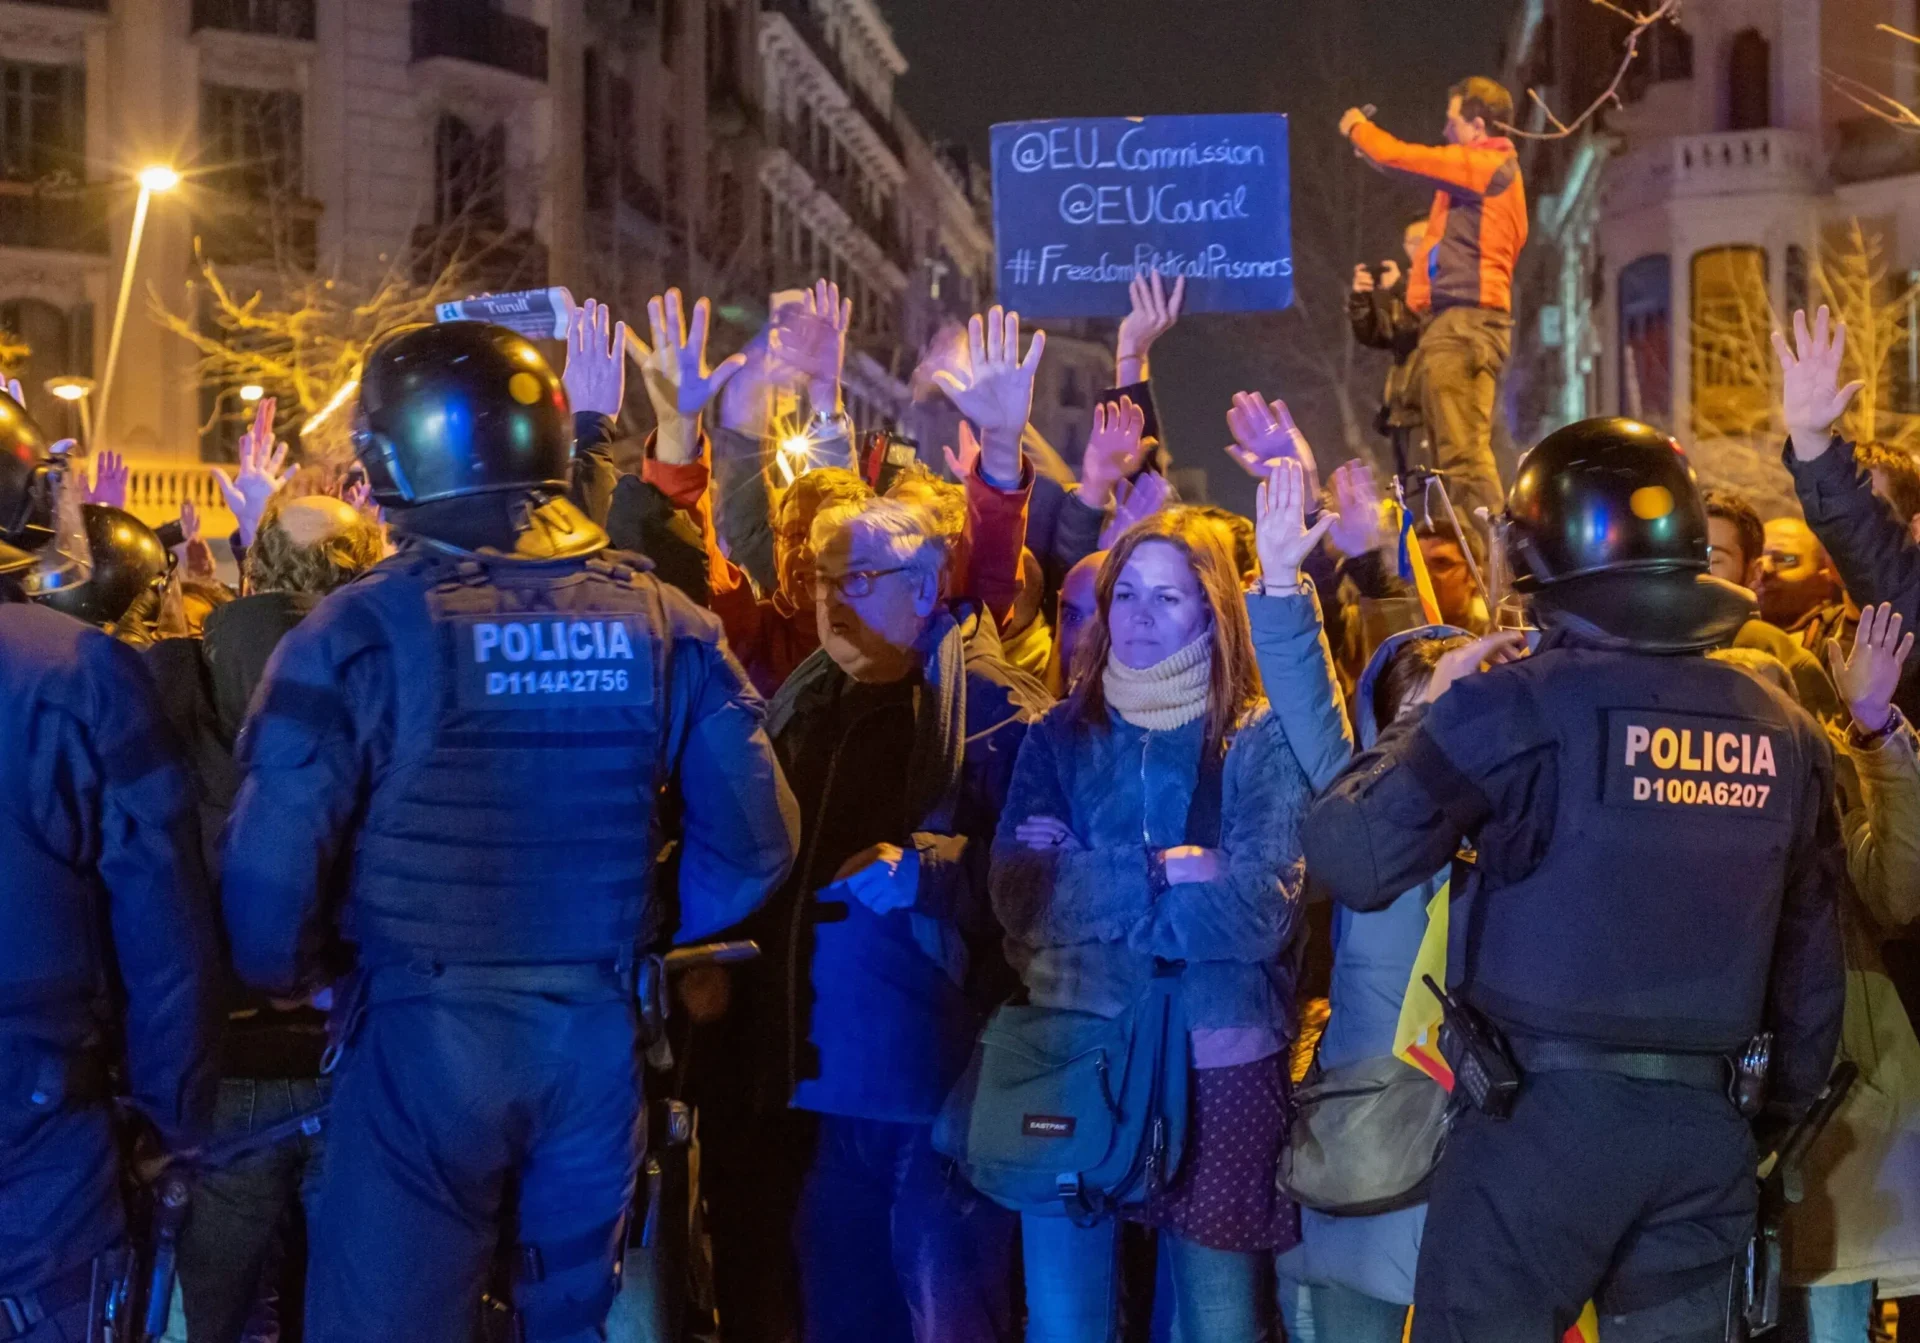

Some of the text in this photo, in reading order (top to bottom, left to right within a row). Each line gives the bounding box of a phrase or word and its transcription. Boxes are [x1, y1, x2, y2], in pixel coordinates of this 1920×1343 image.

[1012, 126, 1265, 172] @EU_Commission
[484, 299, 530, 315] Turull
[473, 621, 634, 663] POLICIA
[486, 669, 629, 695] D114A2756
[1625, 725, 1777, 777] POLICIA
[1633, 777, 1770, 808] D100A6207
